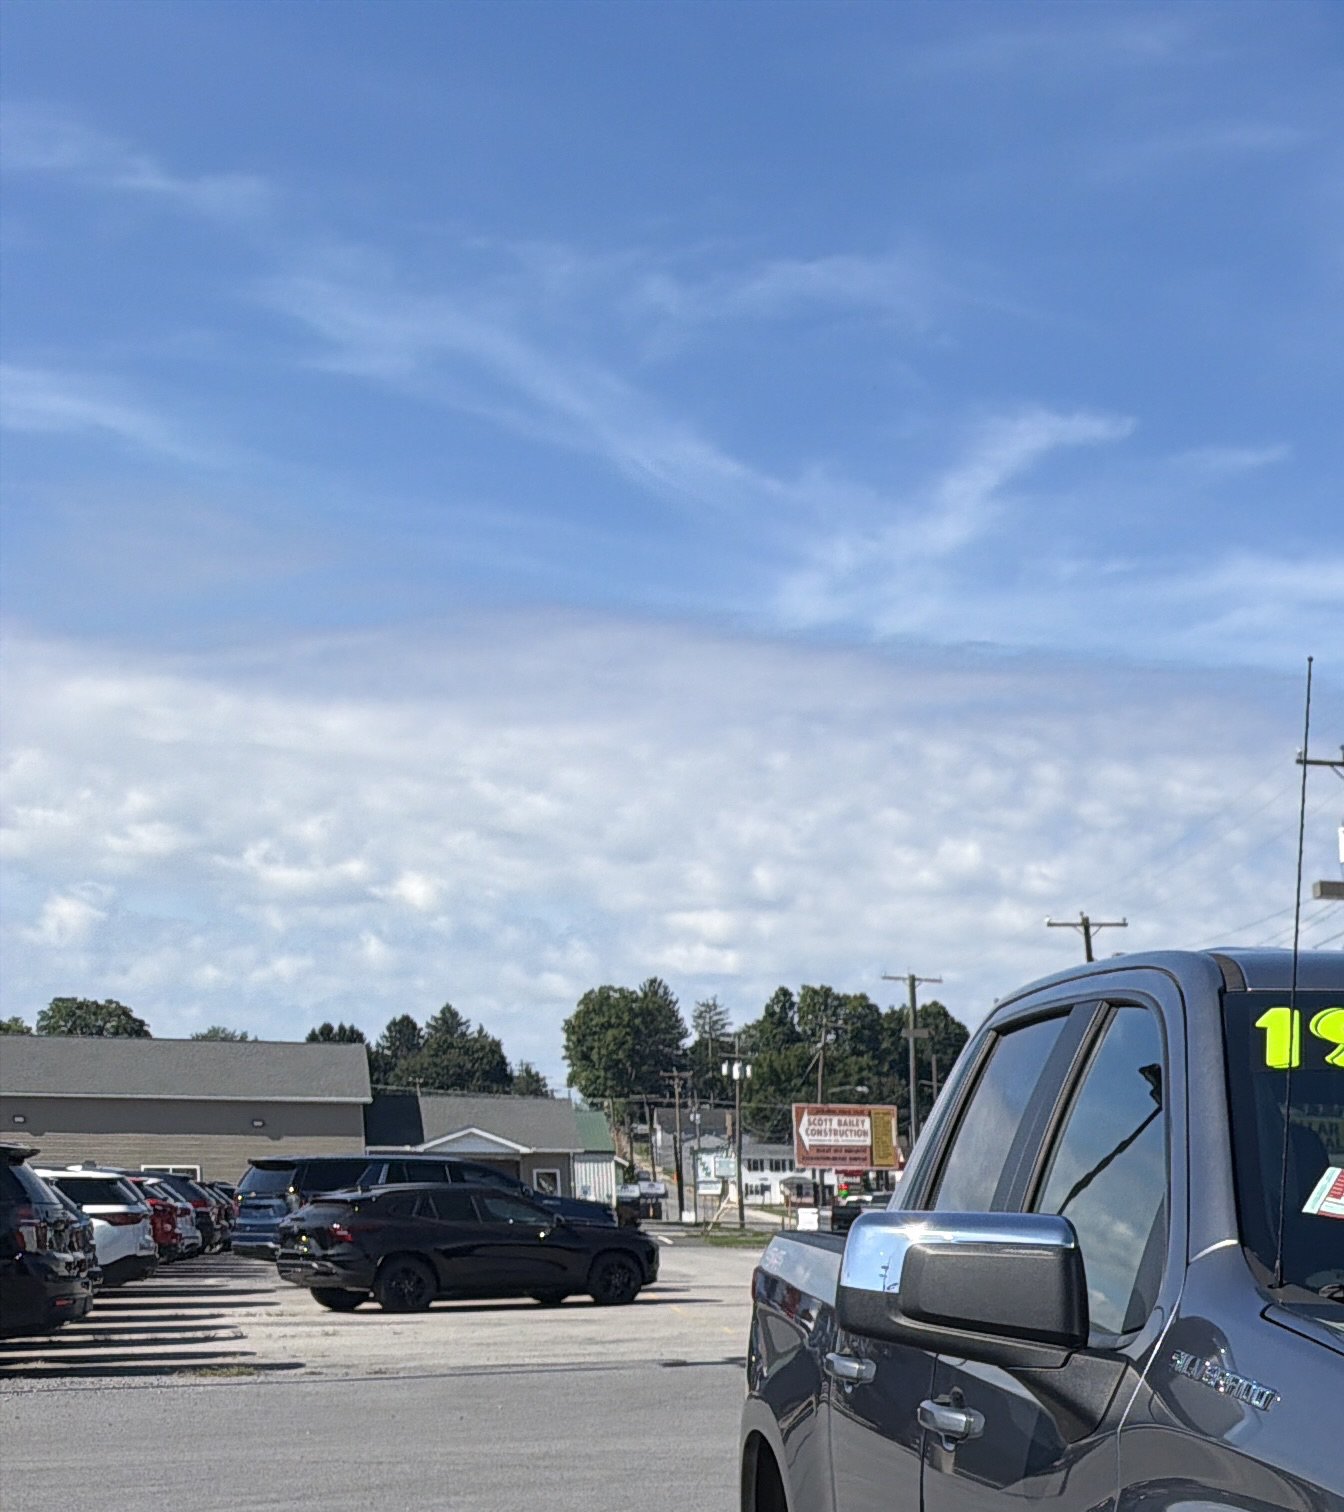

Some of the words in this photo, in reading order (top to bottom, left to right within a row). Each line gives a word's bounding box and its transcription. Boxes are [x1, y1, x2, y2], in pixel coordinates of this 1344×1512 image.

[807, 1118, 833, 1127] SCOTT
[837, 1118, 866, 1127] BAILEY
[804, 1128, 869, 1138] CONSTRUCTION
